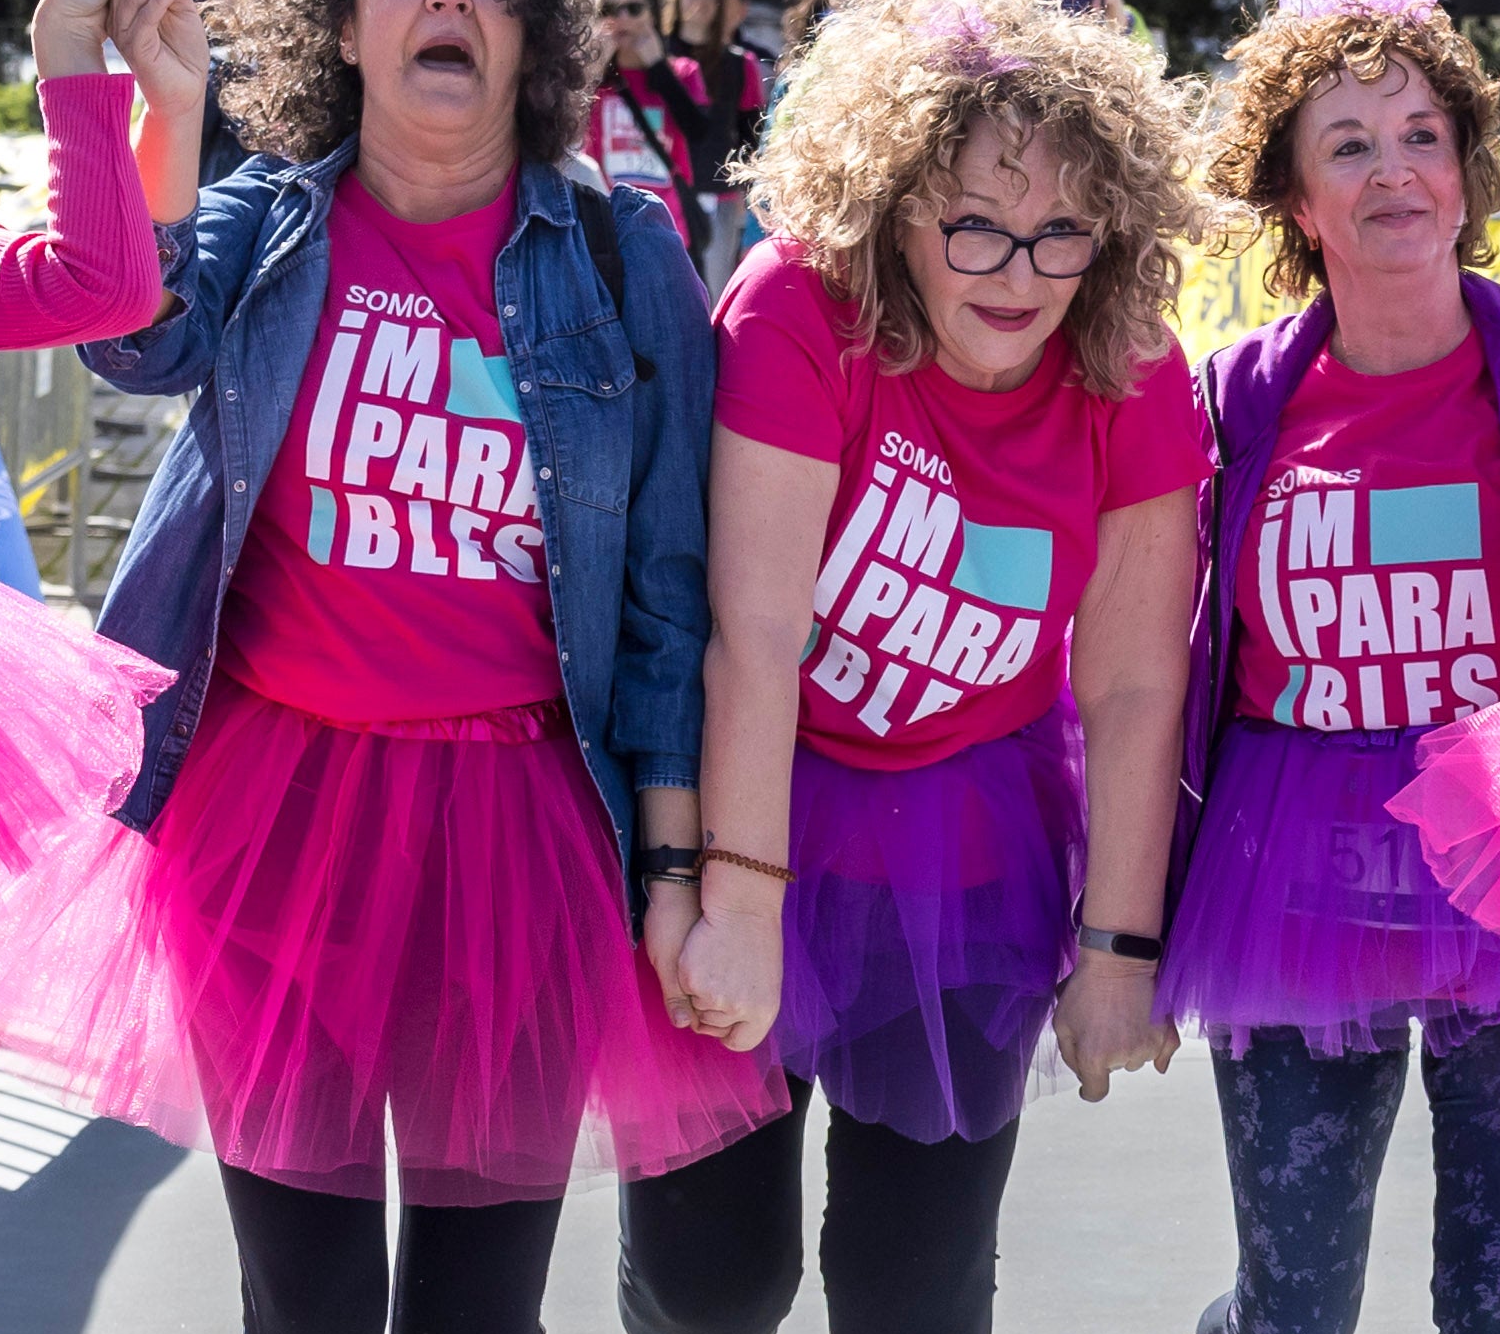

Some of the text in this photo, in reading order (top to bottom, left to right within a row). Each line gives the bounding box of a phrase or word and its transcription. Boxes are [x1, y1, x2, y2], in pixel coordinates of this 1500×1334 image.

[879, 430, 958, 493] SOMO
[1268, 465, 1362, 500] SOMOS
[343, 492, 545, 584] BLES
[837, 560, 1042, 686] PARA
[1288, 568, 1496, 660] PARA
[1303, 652, 1499, 732] BLES
